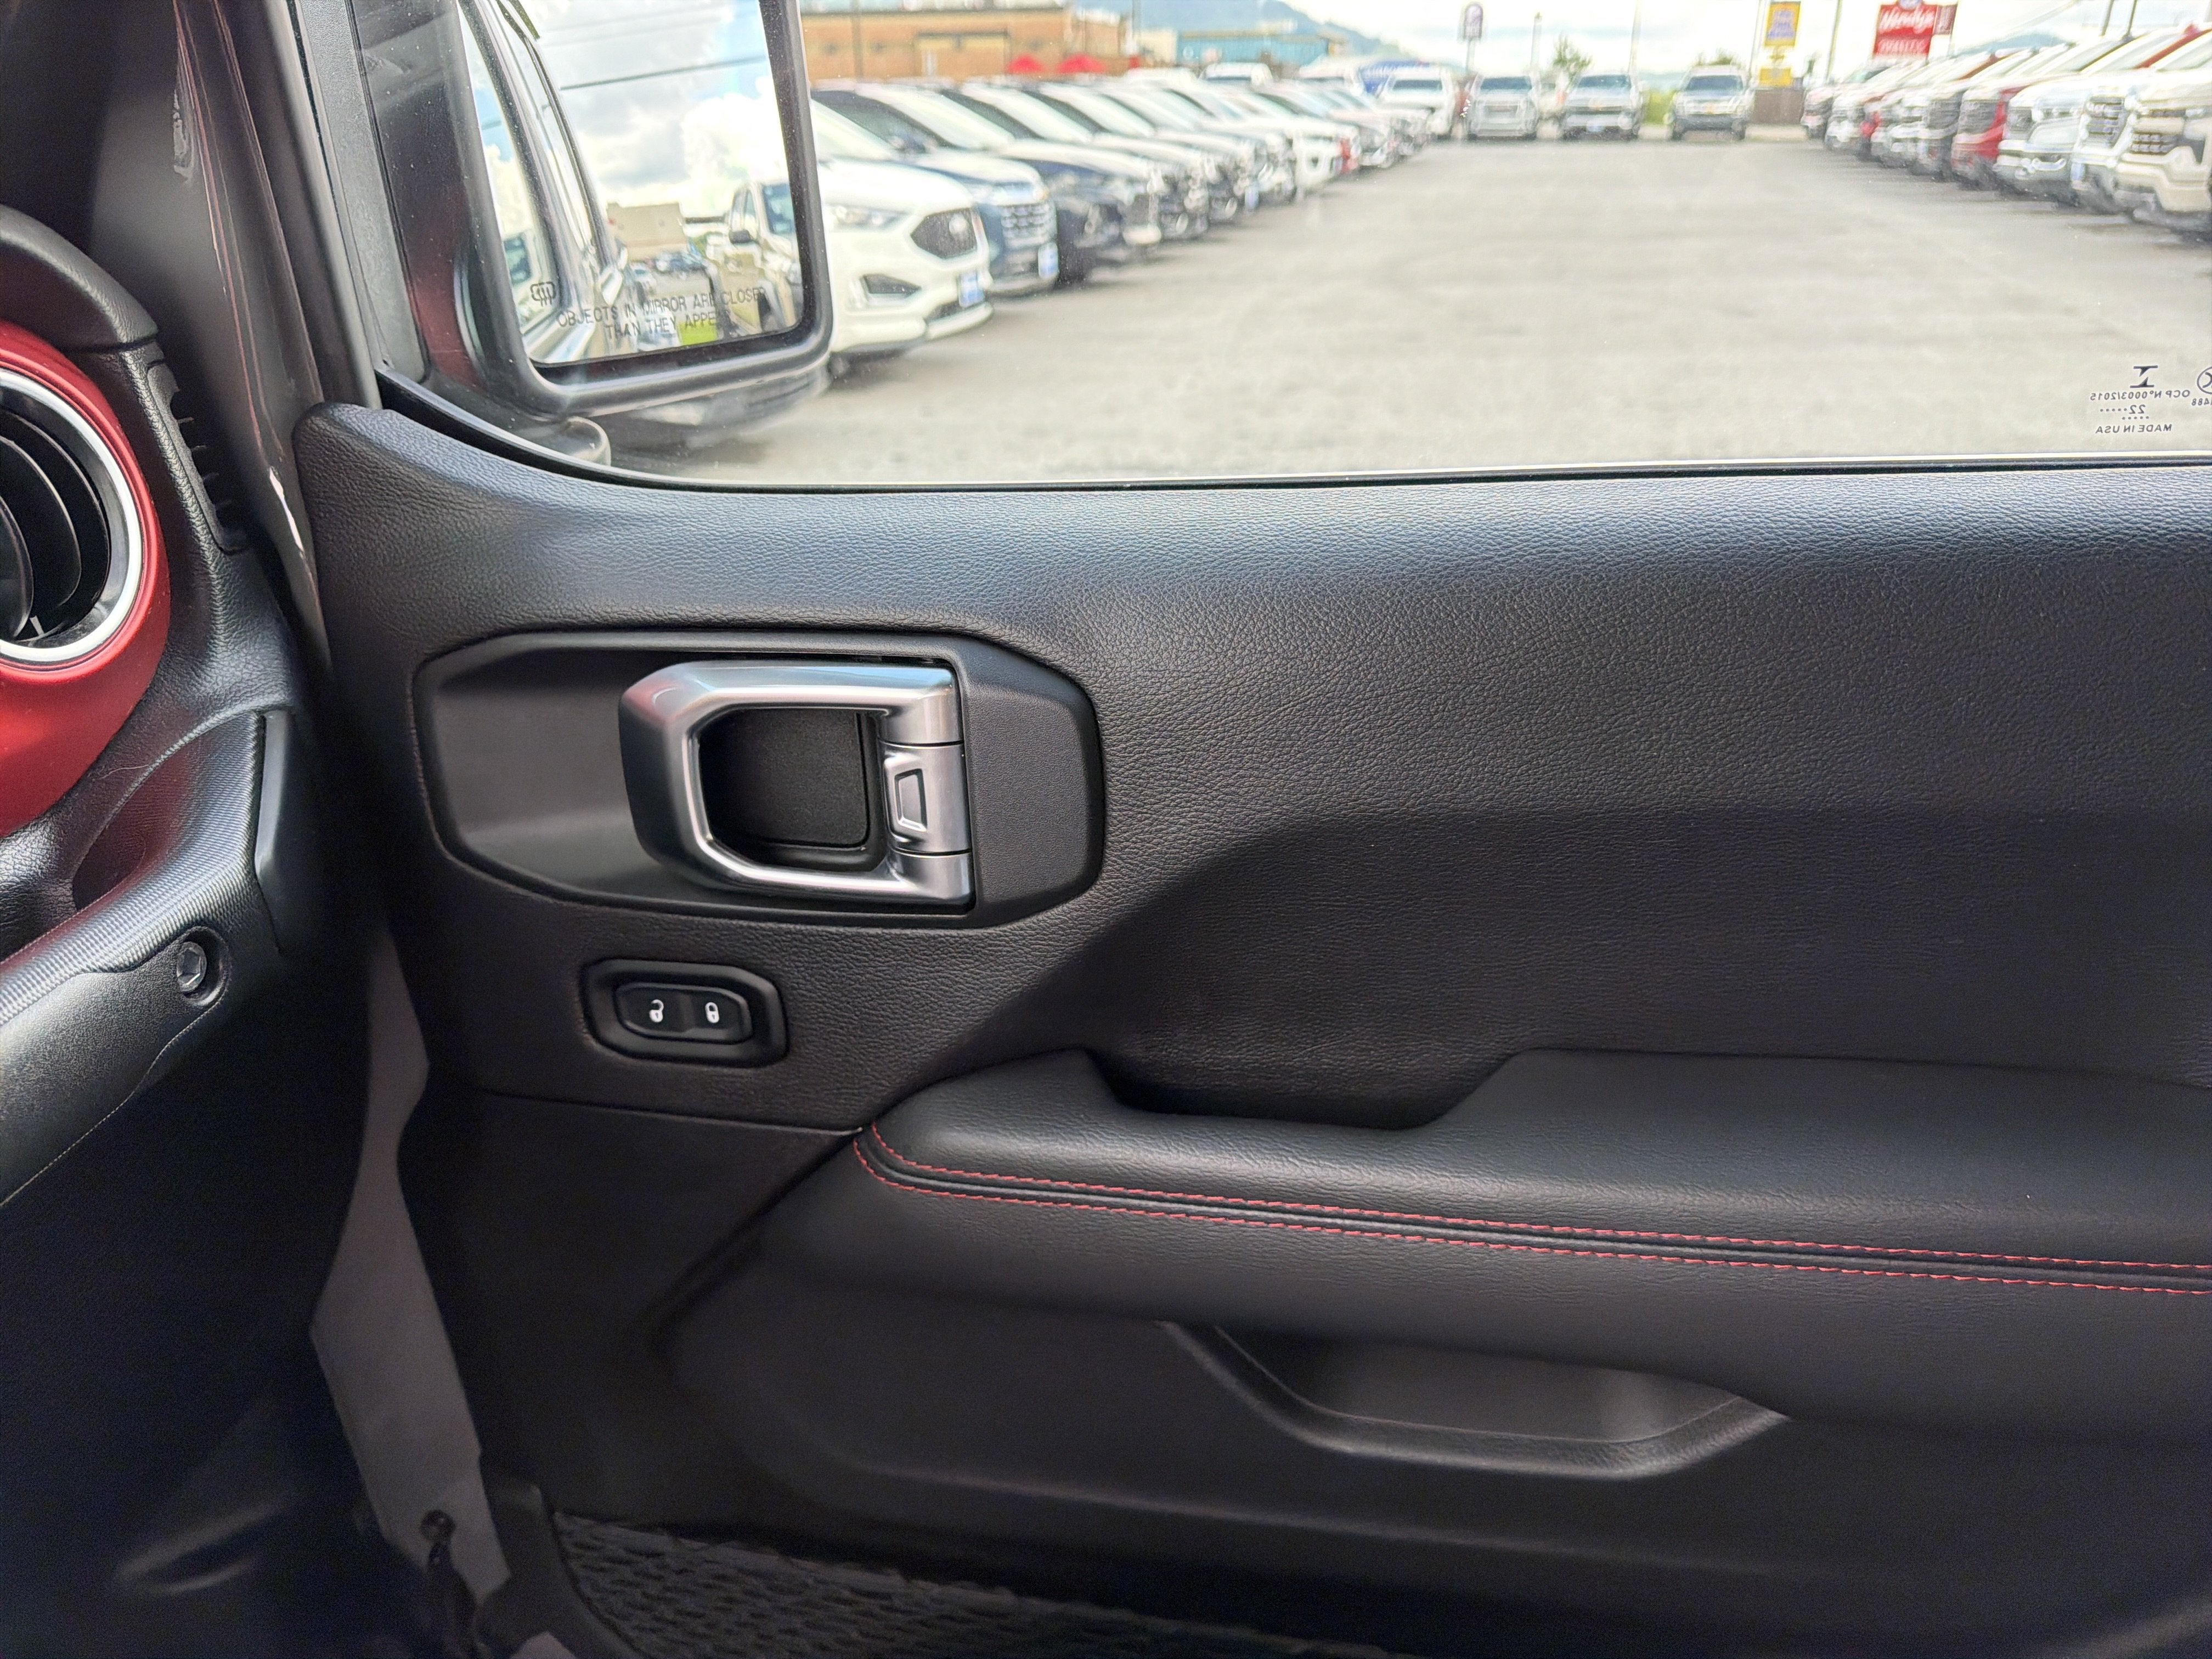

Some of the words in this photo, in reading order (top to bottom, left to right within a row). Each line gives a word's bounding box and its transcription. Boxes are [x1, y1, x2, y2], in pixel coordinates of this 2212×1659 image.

[557, 306, 619, 327] OBJECTS
[625, 303, 637, 318] IN
[604, 320, 641, 339] THAN
[645, 314, 676, 334] THEY
